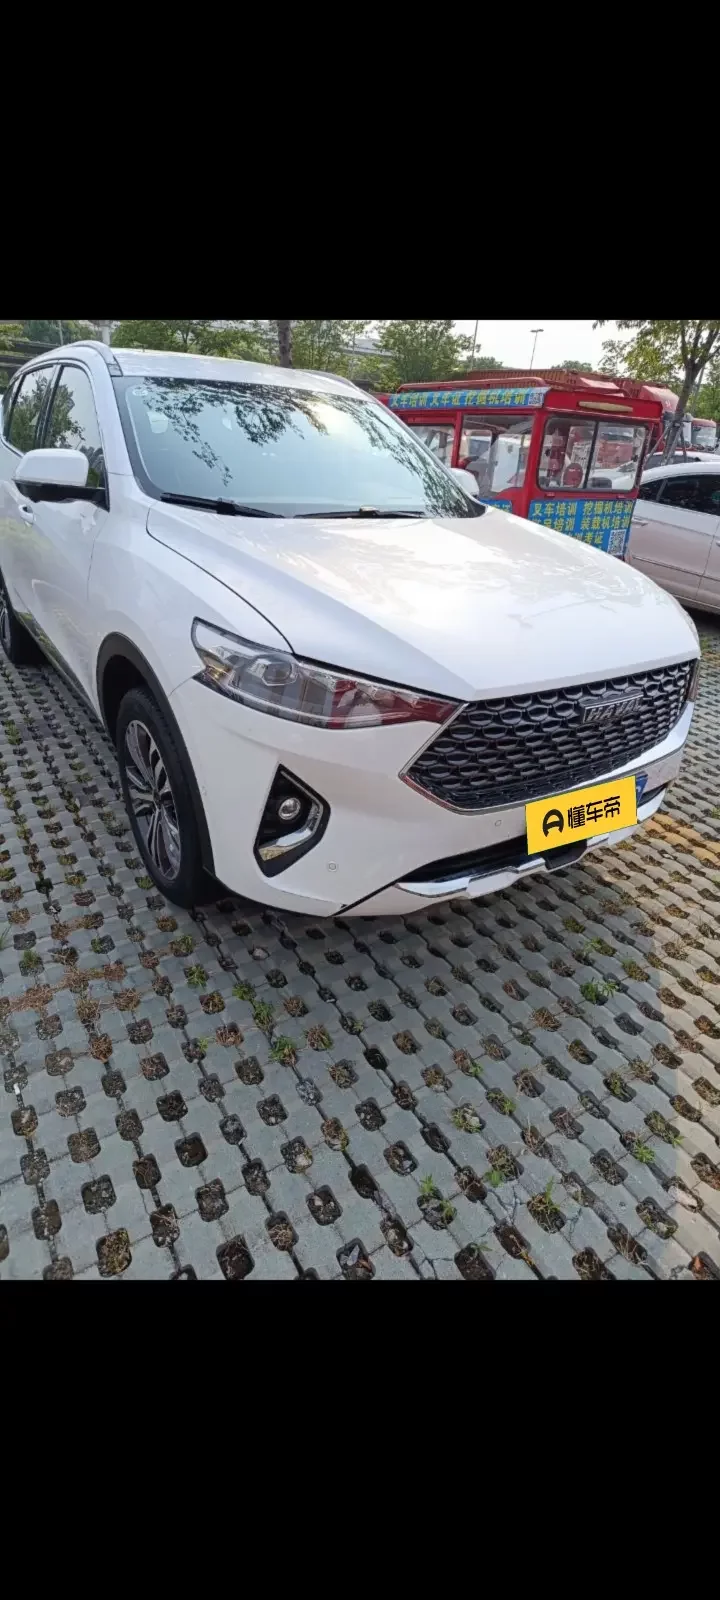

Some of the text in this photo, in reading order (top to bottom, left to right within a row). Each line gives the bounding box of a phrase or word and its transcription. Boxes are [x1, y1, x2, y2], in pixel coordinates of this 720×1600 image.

[532, 500, 634, 516] 叉车培训 挖掘机培训
[580, 516, 630, 530] 装载机培训
[586, 696, 643, 721] HAVAL
